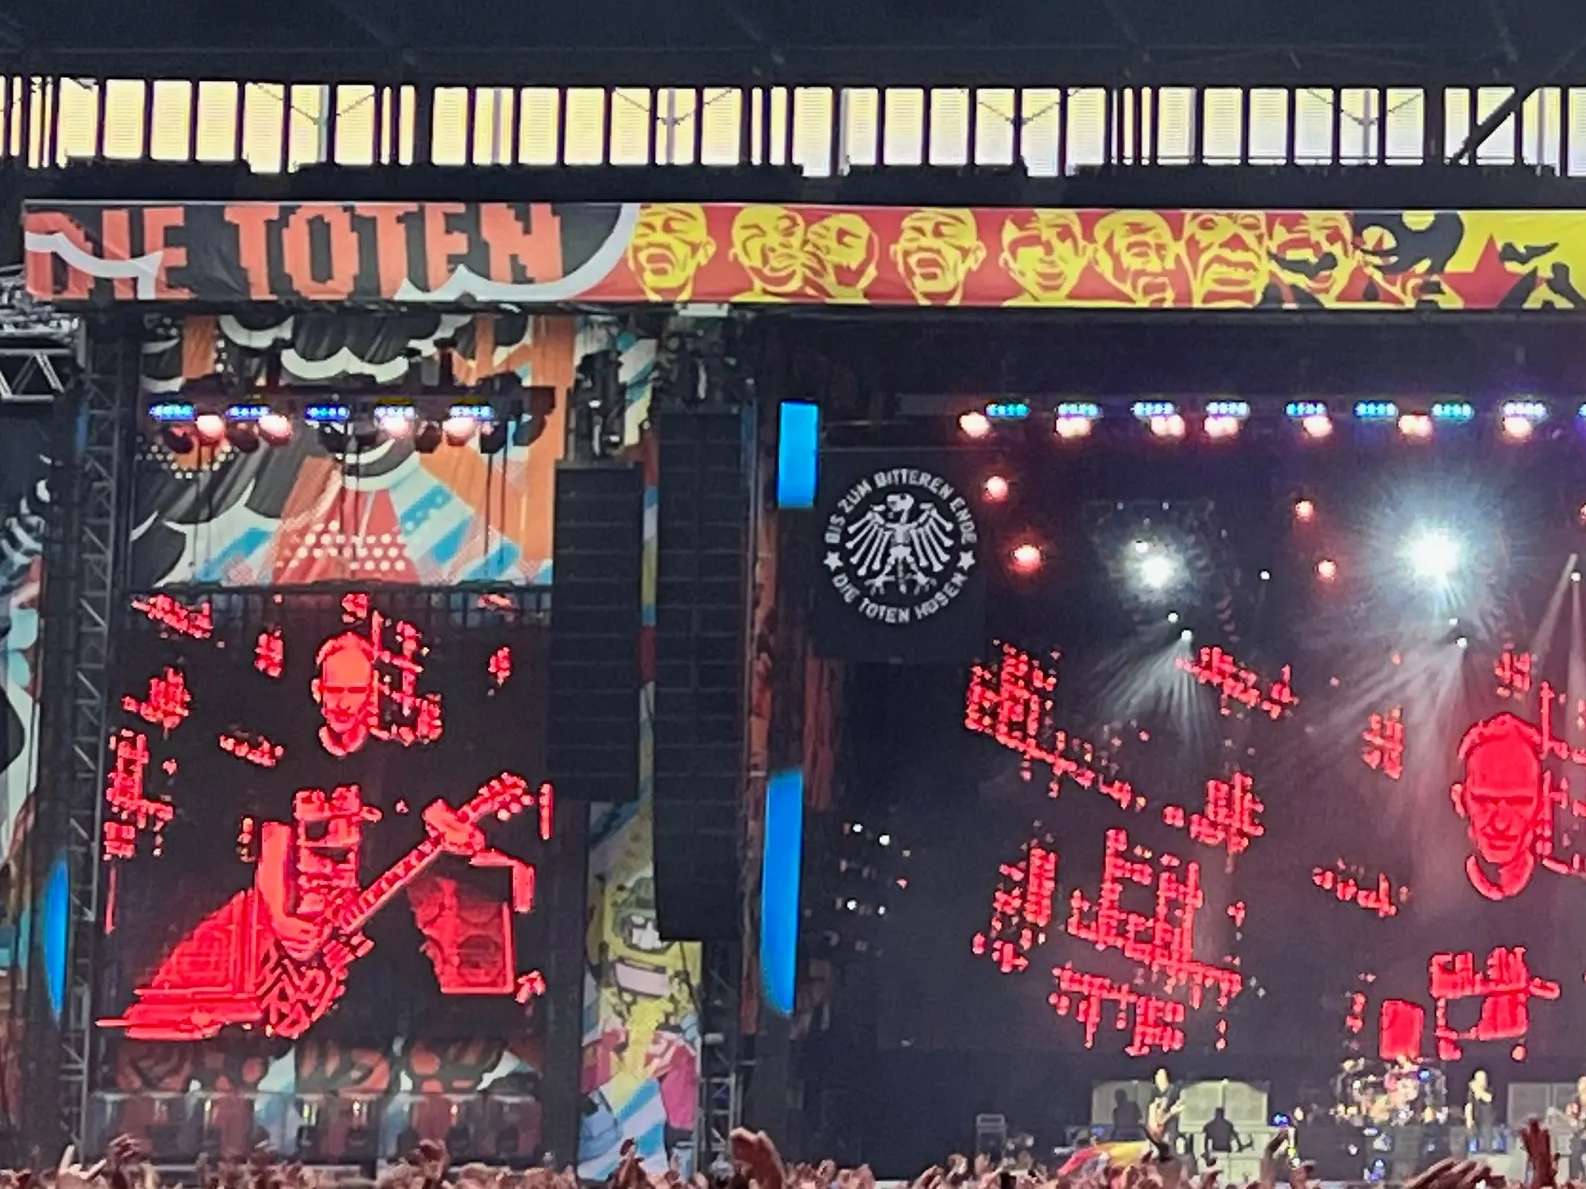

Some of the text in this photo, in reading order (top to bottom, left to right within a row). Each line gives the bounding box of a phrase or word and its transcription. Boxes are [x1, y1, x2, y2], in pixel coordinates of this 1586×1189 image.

[24, 206, 196, 300] DIE
[224, 202, 562, 301] TOTEN
[824, 468, 977, 544] BIS ZUM BITTEREN ENDE
[831, 572, 968, 624] DIE TOTEN HOSEN
